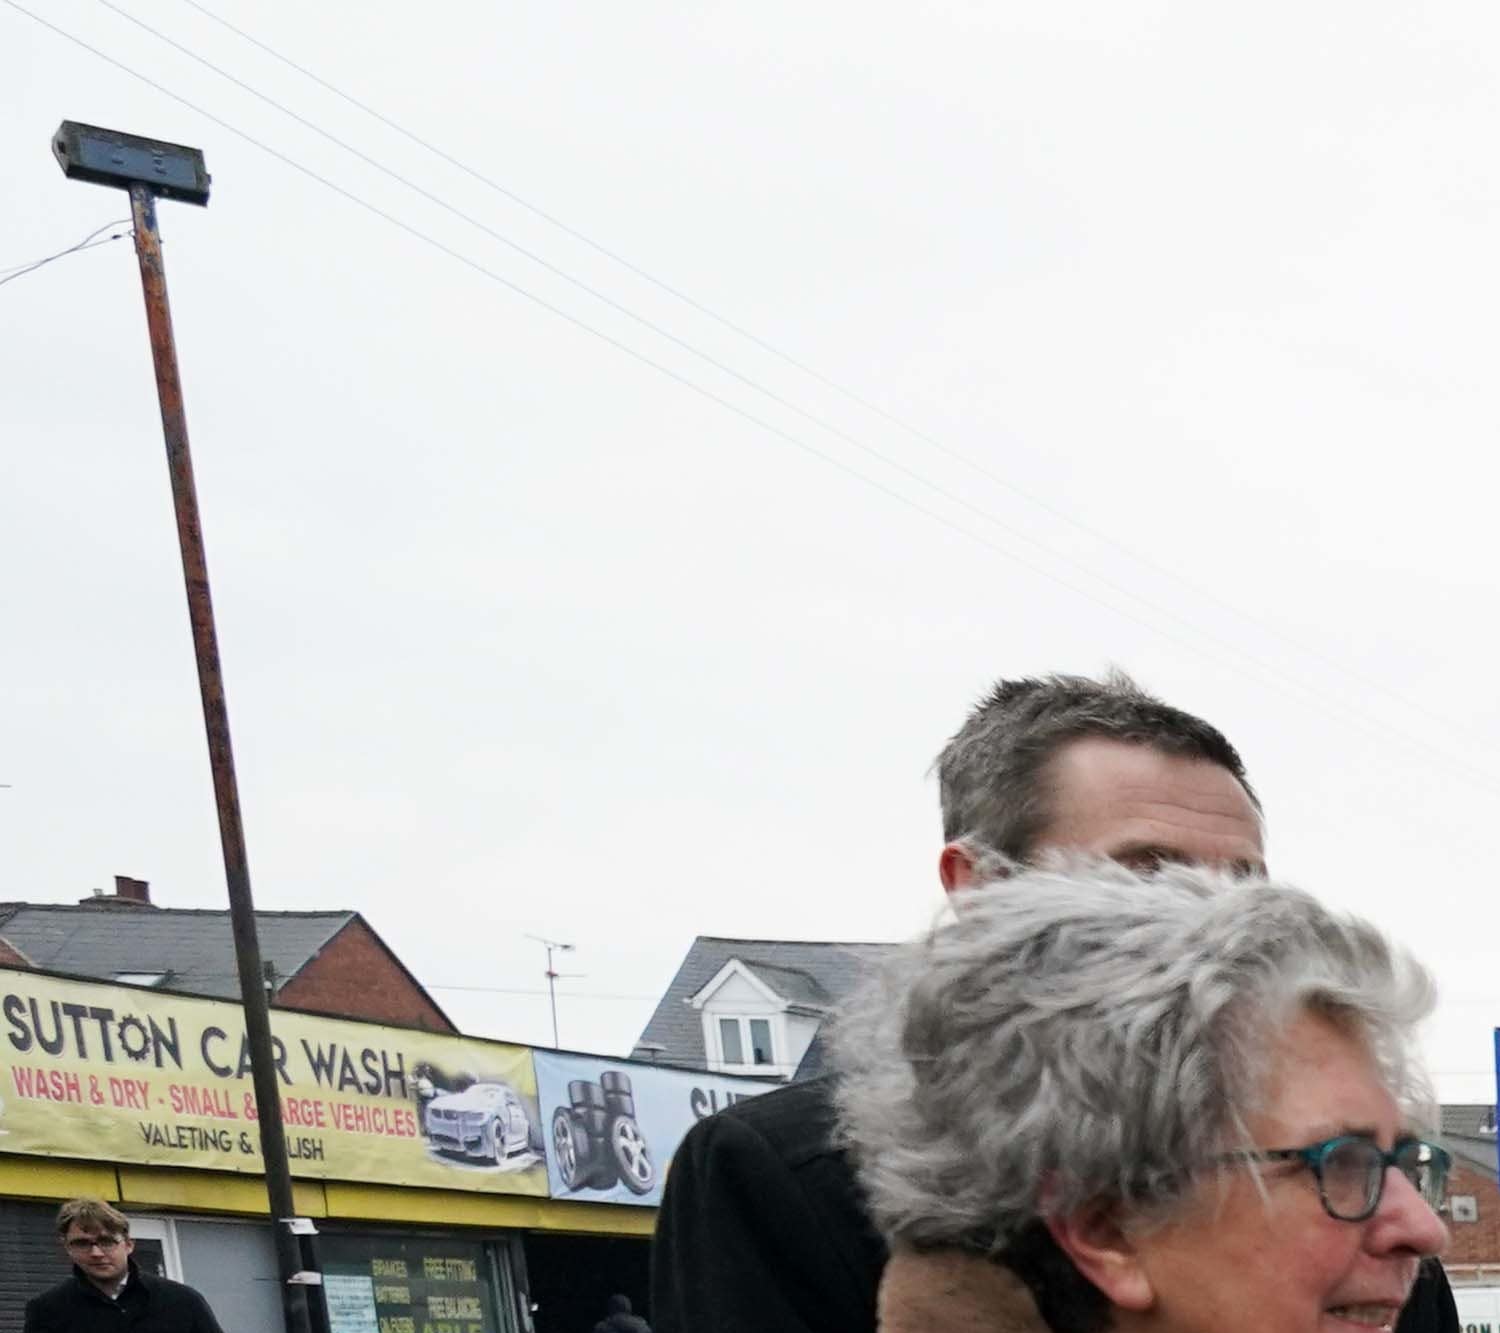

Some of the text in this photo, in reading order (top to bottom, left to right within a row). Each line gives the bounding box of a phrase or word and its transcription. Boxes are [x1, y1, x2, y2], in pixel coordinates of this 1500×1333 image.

[2, 993, 183, 1070] SUTTON
[300, 1038, 409, 1099] WASH
[12, 1065, 81, 1102] WASH
[89, 1077, 104, 1105] &
[109, 1078, 150, 1112] DRY
[170, 1084, 238, 1119] SMALL
[279, 1101, 326, 1129] ARGE
[332, 1104, 417, 1138] VEHICLES
[140, 1121, 232, 1153] VALETING
[237, 1134, 254, 1156] &
